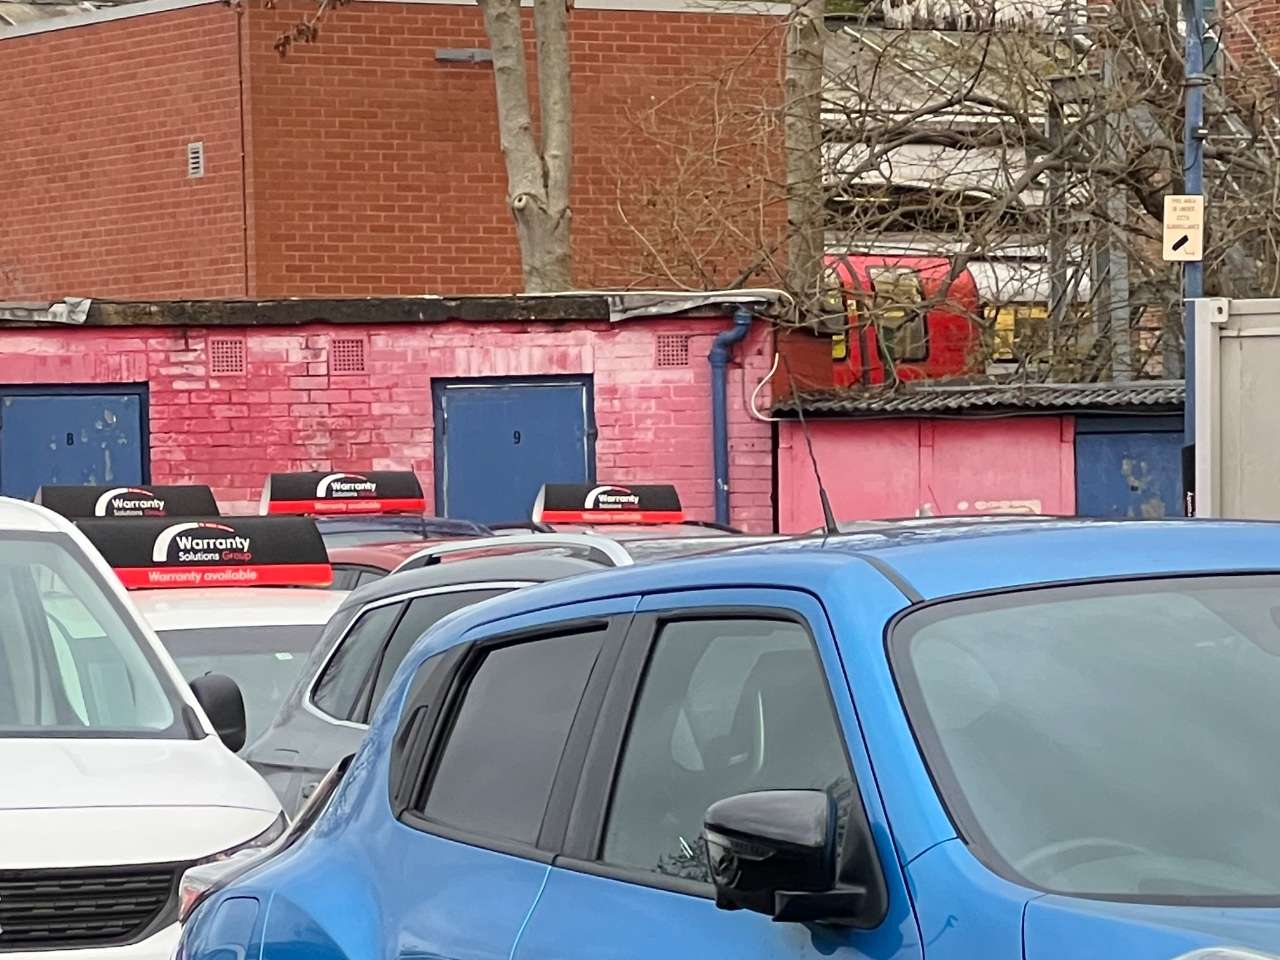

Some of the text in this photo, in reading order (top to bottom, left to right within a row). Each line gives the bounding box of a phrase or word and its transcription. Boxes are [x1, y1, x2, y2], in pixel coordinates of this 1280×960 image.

[66, 432, 74, 446] 8
[513, 430, 521, 445] 9
[331, 482, 377, 492] Warranty
[112, 498, 165, 510] Warranty
[598, 494, 640, 504] Warranty
[176, 535, 250, 552] Warranty
[178, 551, 252, 562] Solutions Group
[148, 569, 257, 584] Warranty available
